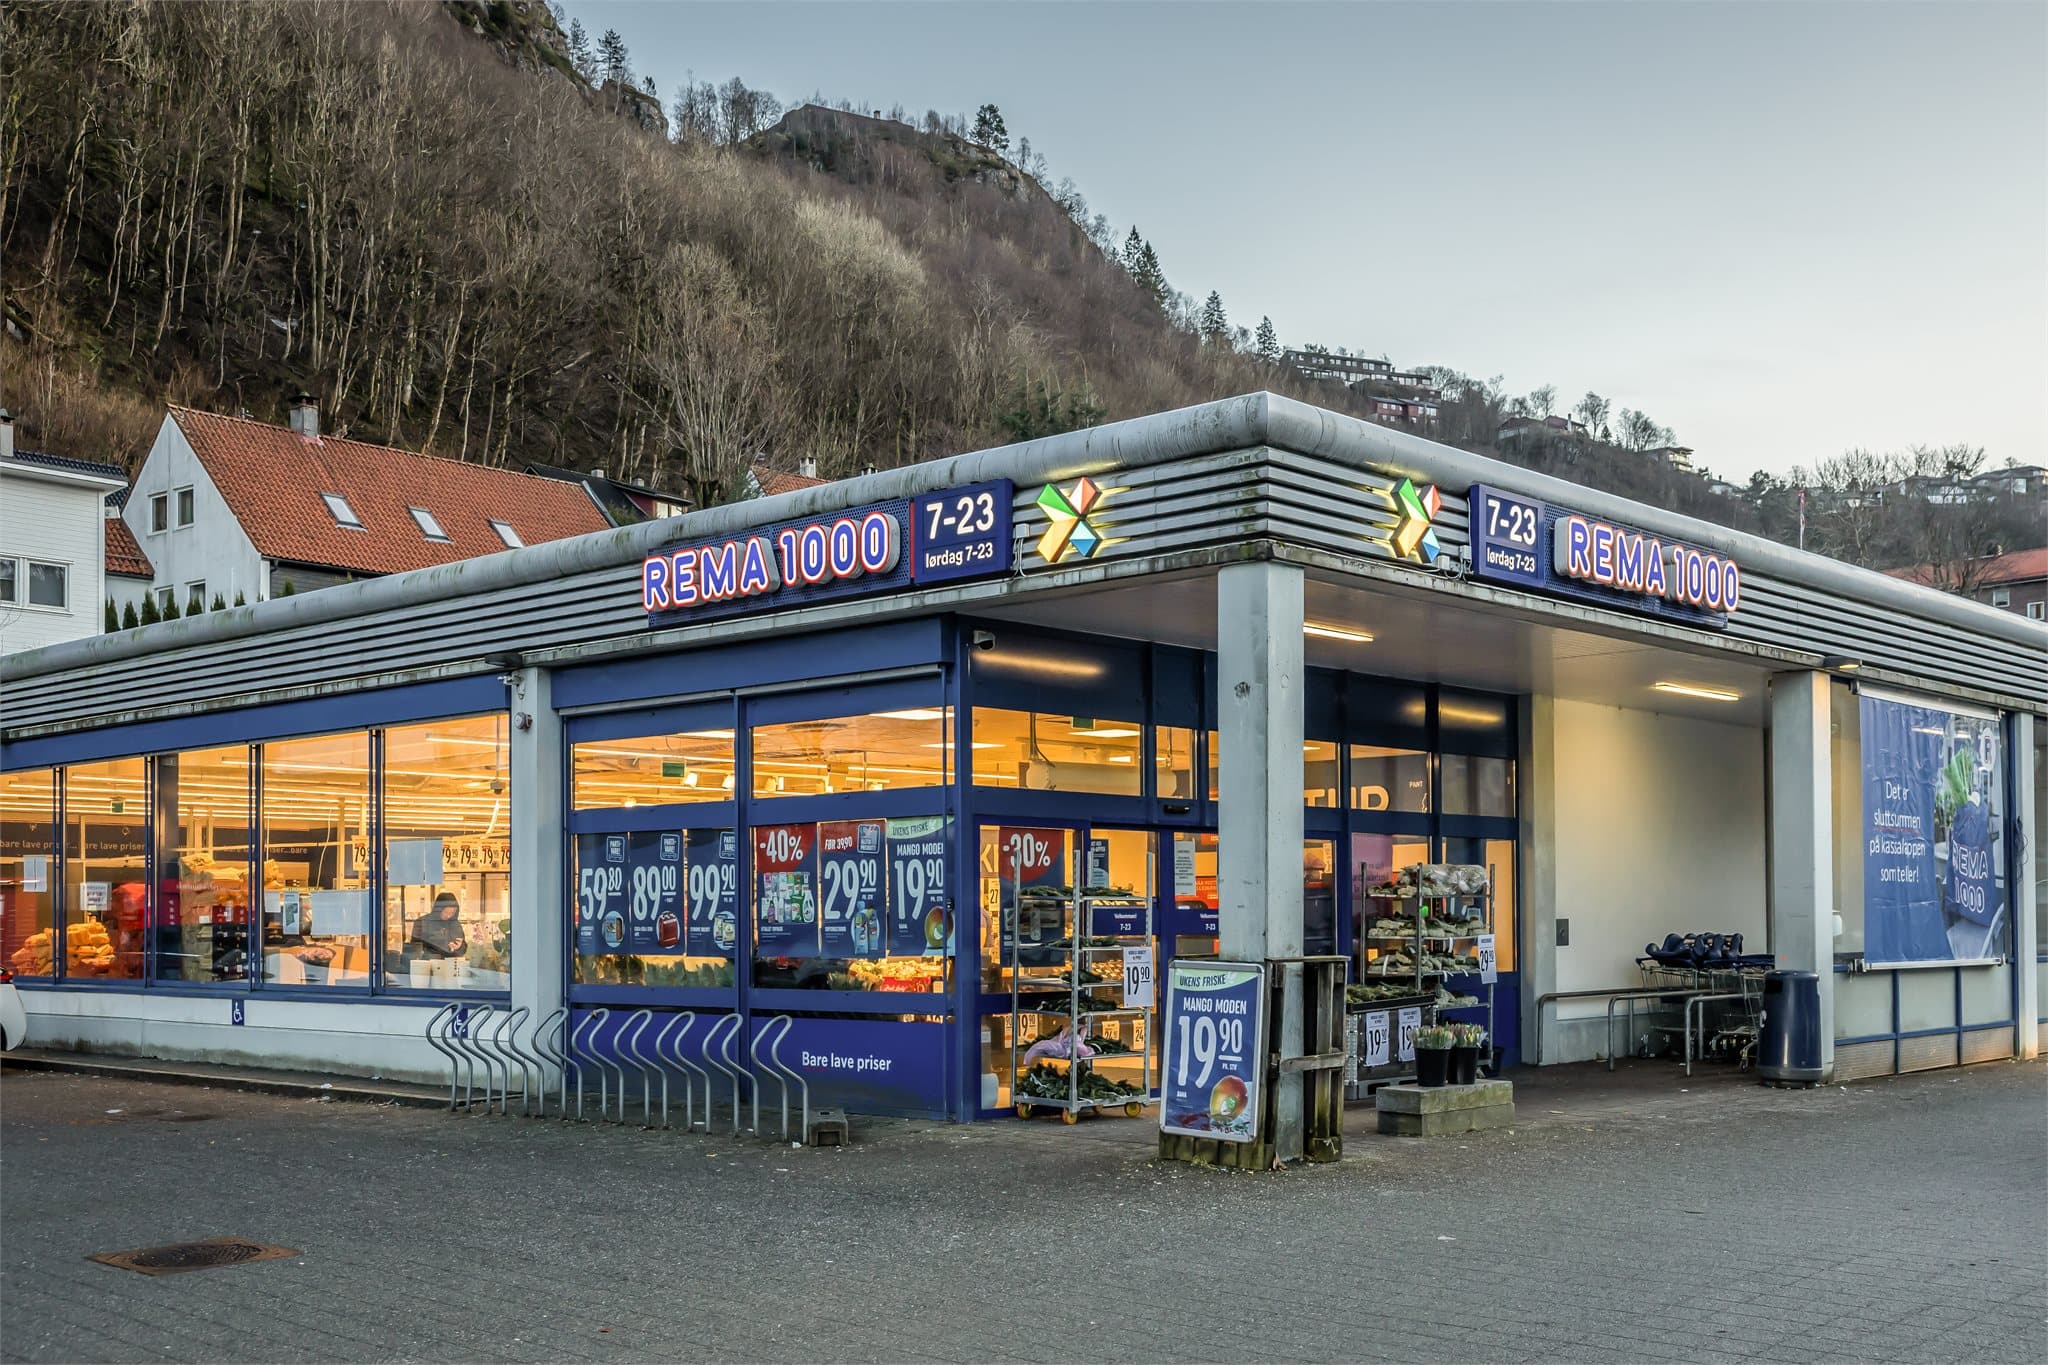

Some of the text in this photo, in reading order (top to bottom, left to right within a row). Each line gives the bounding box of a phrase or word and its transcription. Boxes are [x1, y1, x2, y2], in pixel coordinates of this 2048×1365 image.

[925, 492, 995, 540] 7-23
[1487, 499, 1537, 546] 7-23
[642, 511, 890, 612] REMA 1000
[925, 541, 994, 568] lørdag 7-23
[1487, 547, 1535, 572] lørdag 7-23
[1567, 514, 1740, 613] REMA 1000
[1886, 781, 1900, 800] Det
[1874, 808, 1921, 829] sluttsummen
[760, 829, 803, 863] -40%
[897, 843, 920, 856] MANGO
[1003, 833, 1051, 868] -30%
[1869, 836, 1926, 858] på kassalappen
[1952, 839, 1988, 879] REMA
[1881, 867, 1896, 882] som
[1955, 876, 1985, 914] 1000
[1180, 974, 1226, 987] UKENS FRISKE
[1183, 997, 1247, 1015] MANGO MODEN
[802, 1051, 892, 1073] Bare lave priser
